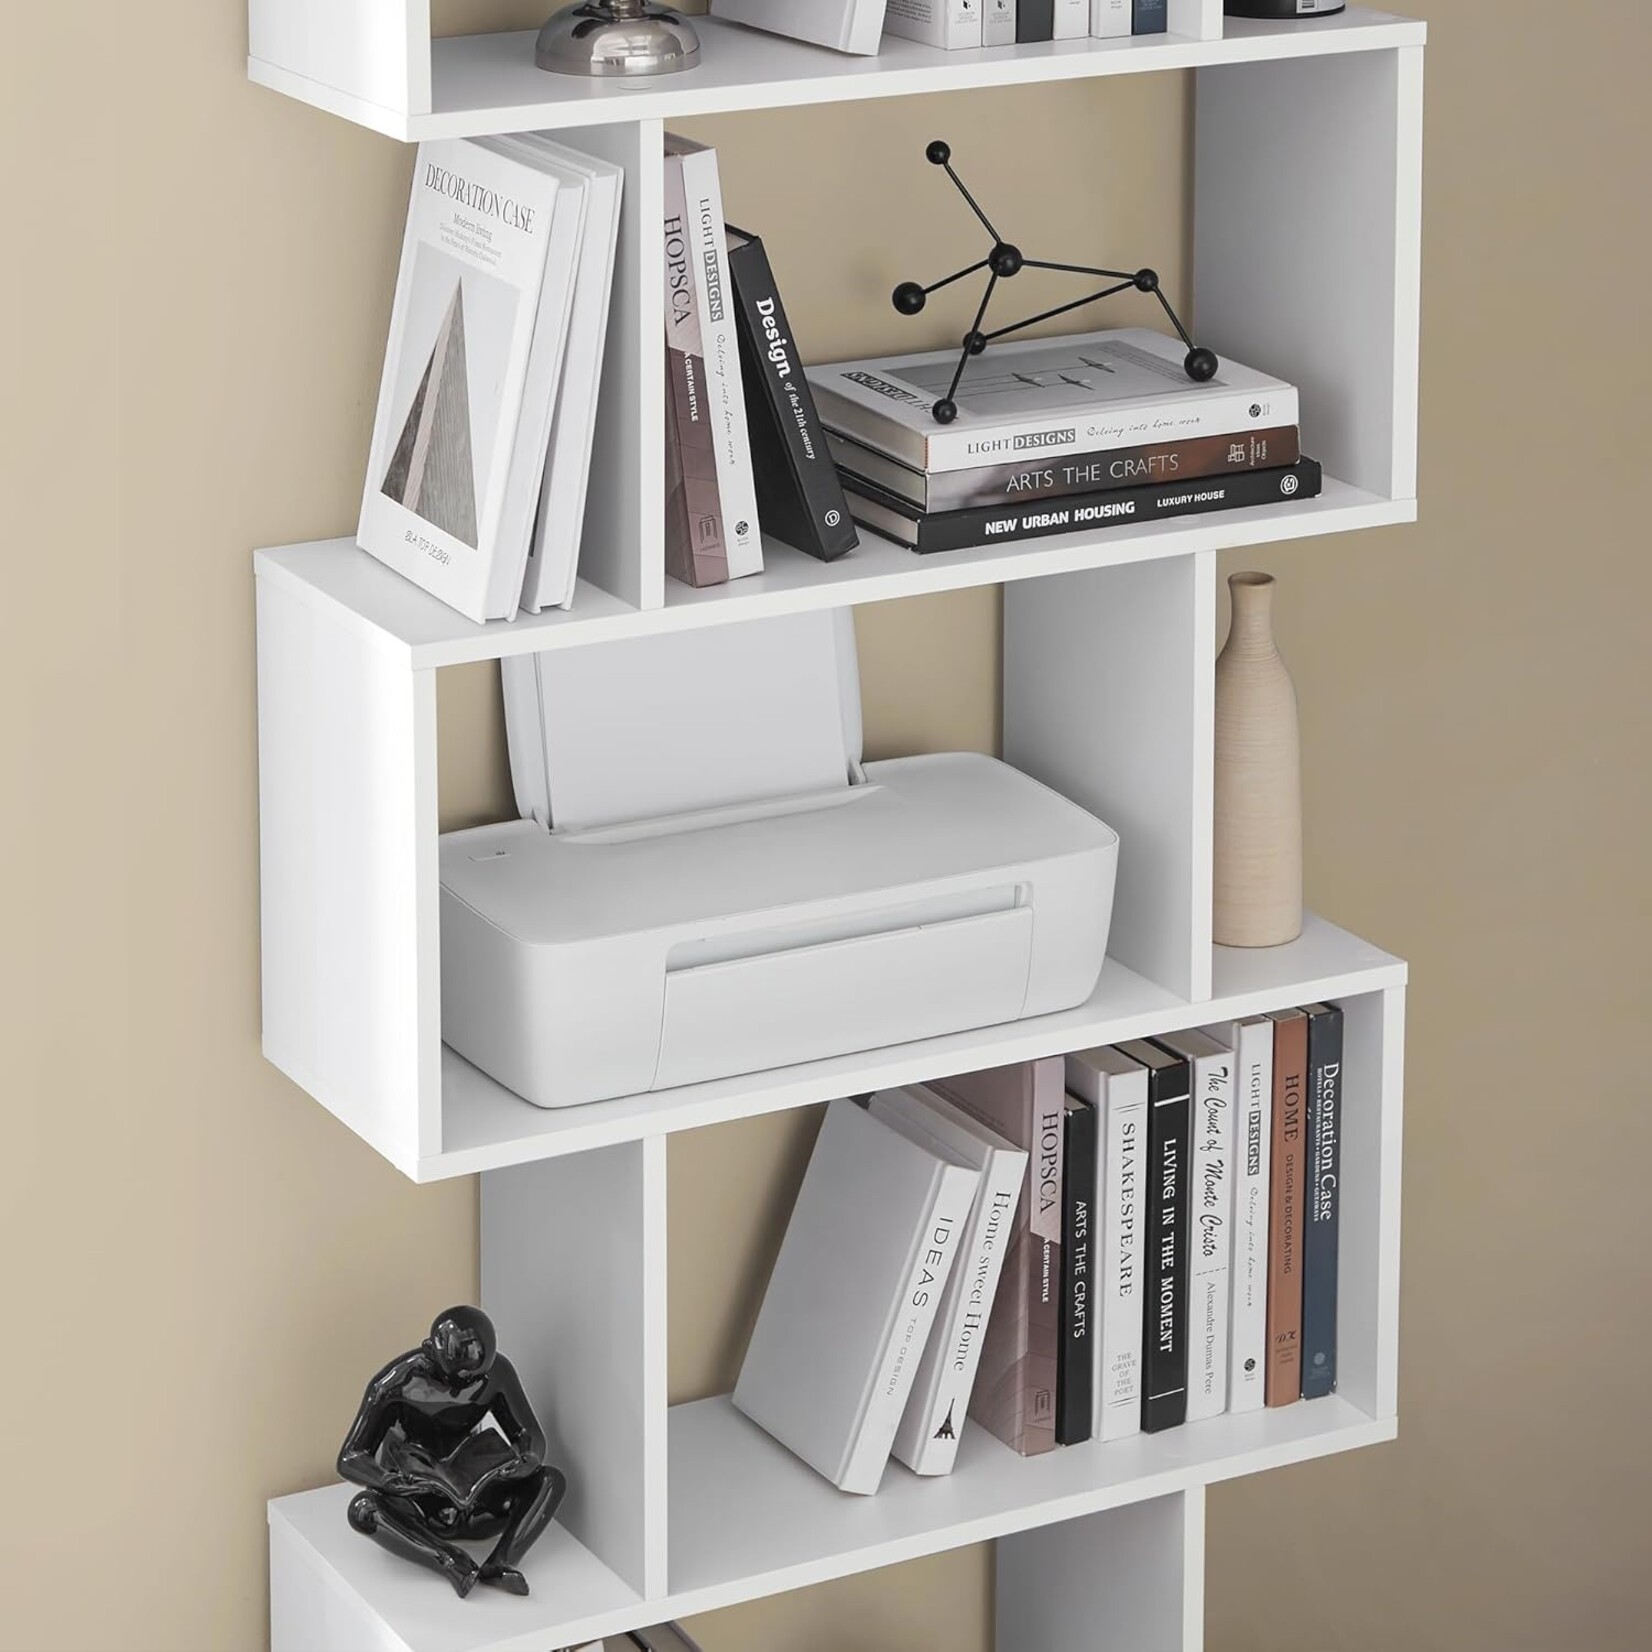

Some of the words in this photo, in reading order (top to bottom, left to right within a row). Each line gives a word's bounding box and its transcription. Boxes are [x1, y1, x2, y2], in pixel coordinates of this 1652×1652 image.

[425, 163, 503, 218] DECORATION
[502, 199, 535, 234] CASE
[700, 198, 714, 248] LIGHT
[664, 214, 692, 327] HOPSCA
[704, 250, 724, 322] DESIGNS
[756, 297, 792, 379] Design
[685, 358, 696, 395] CERTAIN
[784, 381, 797, 392] of
[789, 393, 800, 408] the
[689, 395, 699, 422] STYLE
[793, 407, 806, 428] 21th
[800, 427, 816, 460] century
[968, 437, 1012, 454] LIGHT
[1014, 429, 1075, 450] DESIGNS
[1006, 470, 1054, 493] ARTS
[1063, 463, 1101, 486] THE
[1109, 454, 1179, 479] CRAFTS
[985, 519, 1020, 535] NEW
[1022, 511, 1069, 530] URBAN
[1074, 501, 1136, 522] HOUSING
[1157, 494, 1193, 508] LUXURY
[1194, 489, 1225, 501] HOUSE
[1208, 1066, 1229, 1092] The
[1250, 1063, 1261, 1111] LIGHT
[1204, 1097, 1227, 1135] Count
[1284, 1074, 1300, 1142] HOME
[1321, 1061, 1339, 1171] Decoration
[1040, 1112, 1059, 1214] HOPSCA
[1200, 1137, 1224, 1152] of
[1248, 1111, 1261, 1175] DESIGNS
[1162, 1138, 1177, 1200] LIVING
[1204, 1159, 1225, 1208] Monte
[1285, 1154, 1293, 1194] DESIGN
[983, 1191, 1011, 1251] Home
[1075, 1200, 1087, 1239] ARTS
[1120, 1122, 1135, 1297] SHAKESPEARE
[1162, 1206, 1175, 1225] IN
[1320, 1173, 1337, 1221] Case
[1074, 1243, 1087, 1276] THE
[1161, 1231, 1175, 1270] THE
[1199, 1213, 1223, 1258] Cristo
[1284, 1206, 1293, 1274] DECORATING
[912, 1216, 953, 1308] IDEAS
[970, 1255, 990, 1306] sweet
[1043, 1244, 1051, 1278] CERTAIN
[905, 1317, 916, 1343] TOP
[1073, 1281, 1087, 1339] CRAFTS
[1160, 1276, 1174, 1352] MOMENT
[1206, 1282, 1216, 1333] Alexandre
[954, 1311, 983, 1372] Home
[1205, 1334, 1215, 1368] Dumas
[886, 1346, 907, 1396] DESIGN
[1204, 1371, 1214, 1394] Pere
